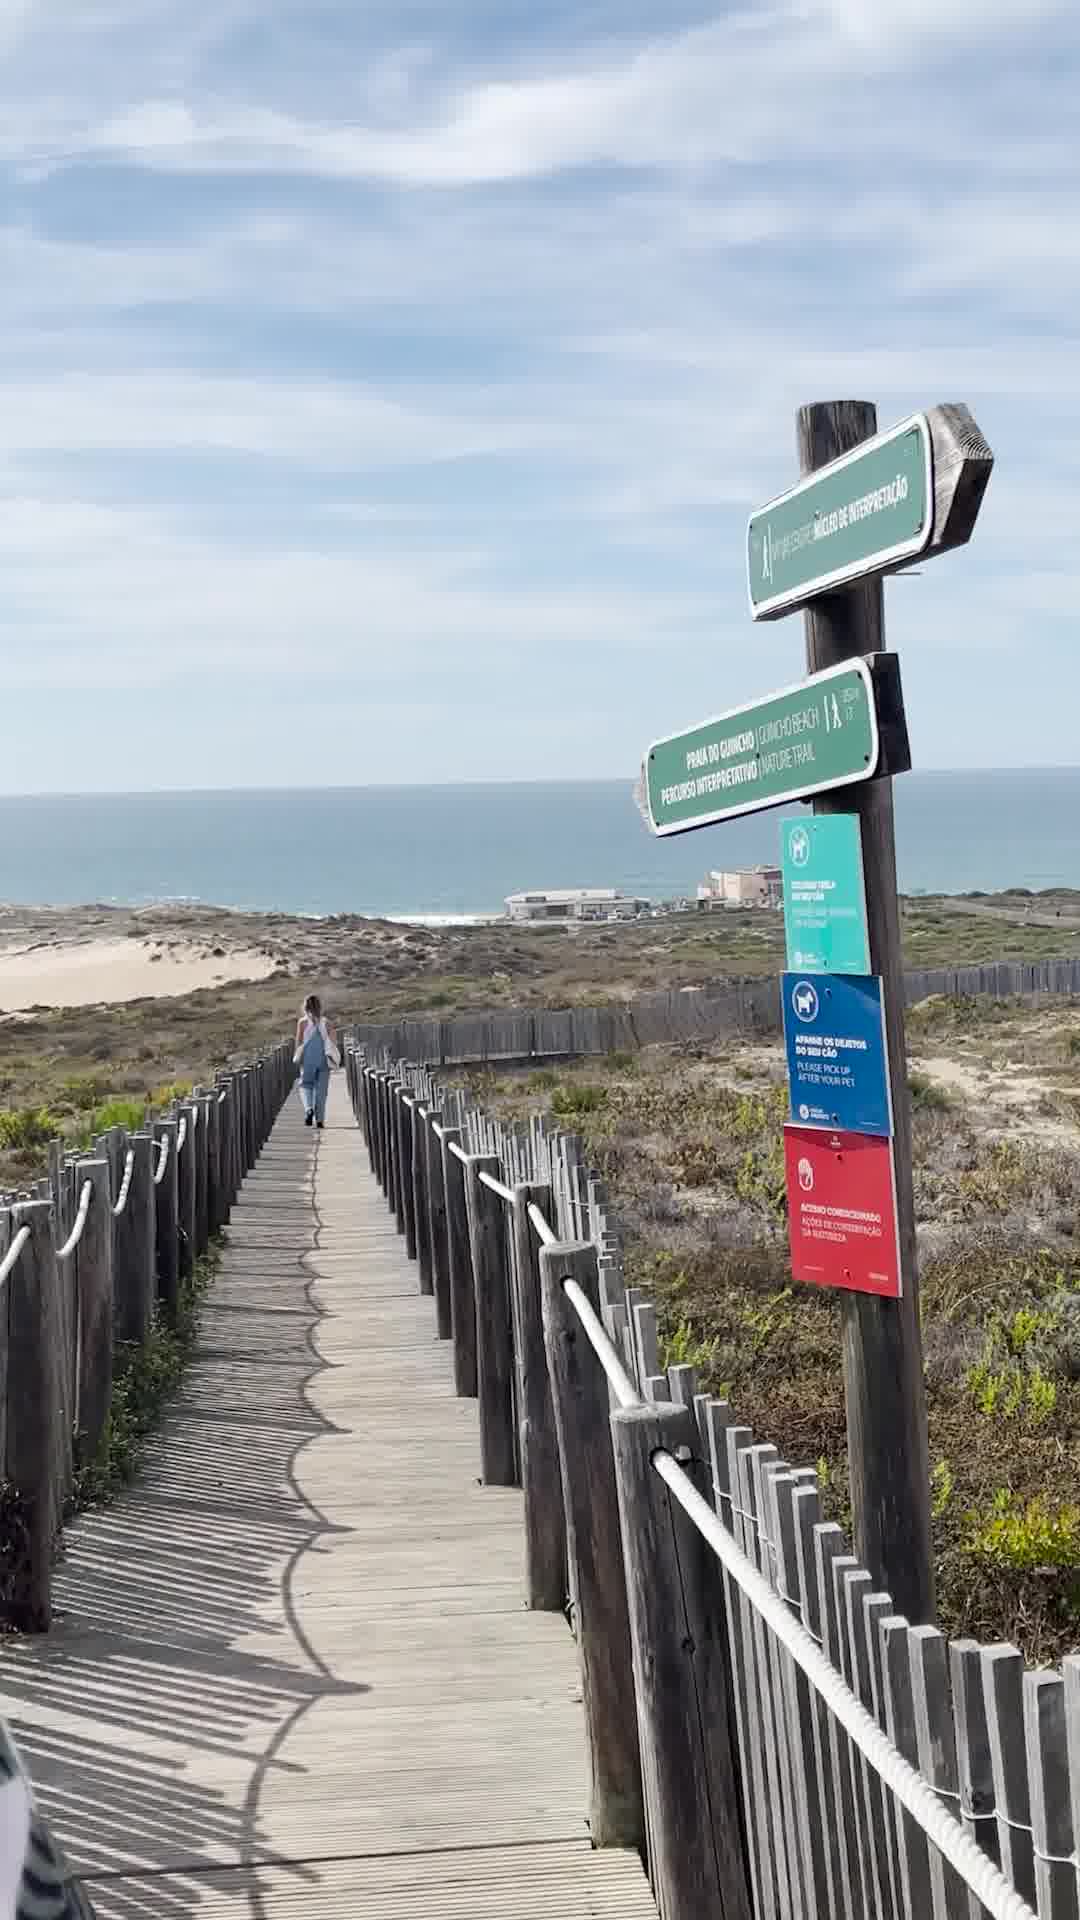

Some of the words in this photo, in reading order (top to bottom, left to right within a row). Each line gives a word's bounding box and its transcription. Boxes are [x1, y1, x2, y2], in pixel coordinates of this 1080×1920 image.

[686, 746, 707, 770] PRAIA
[708, 743, 719, 763] DO
[824, 1037, 834, 1048] OS
[795, 1046, 807, 1056] DO
